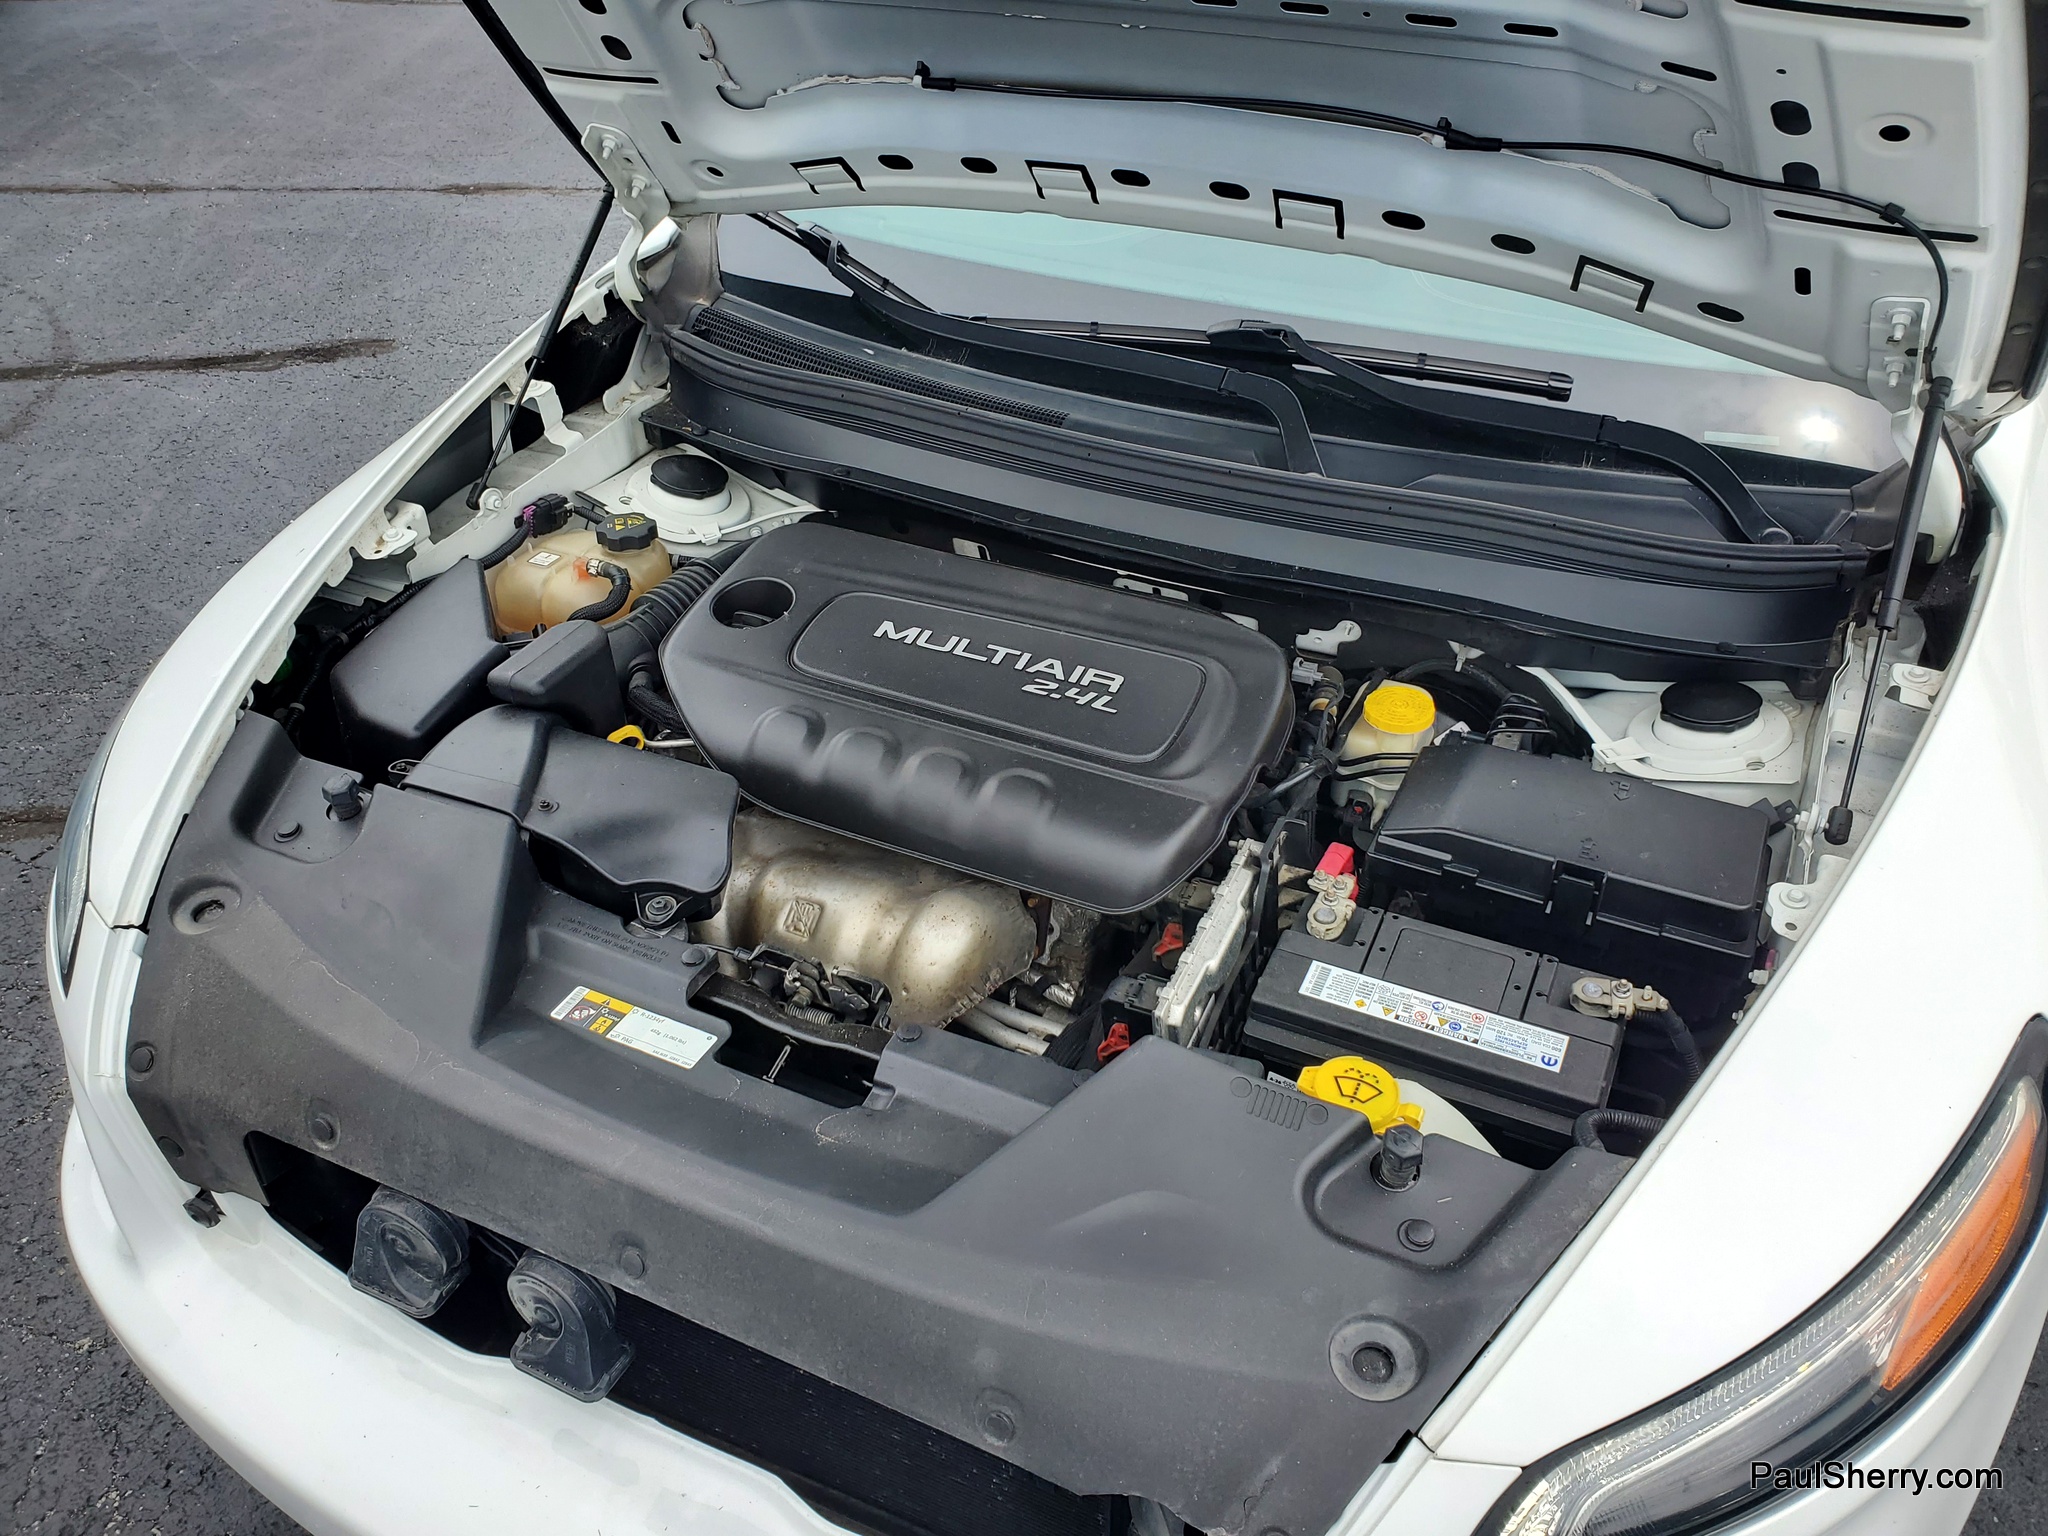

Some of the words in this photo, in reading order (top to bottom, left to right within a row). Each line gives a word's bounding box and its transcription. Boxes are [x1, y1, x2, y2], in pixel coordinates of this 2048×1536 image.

[872, 620, 1125, 693] MULTIAIR
[1021, 678, 1118, 714] 2.4L
[1398, 1015, 1426, 1028] POISON
[1433, 1026, 1464, 1039] DANGER
